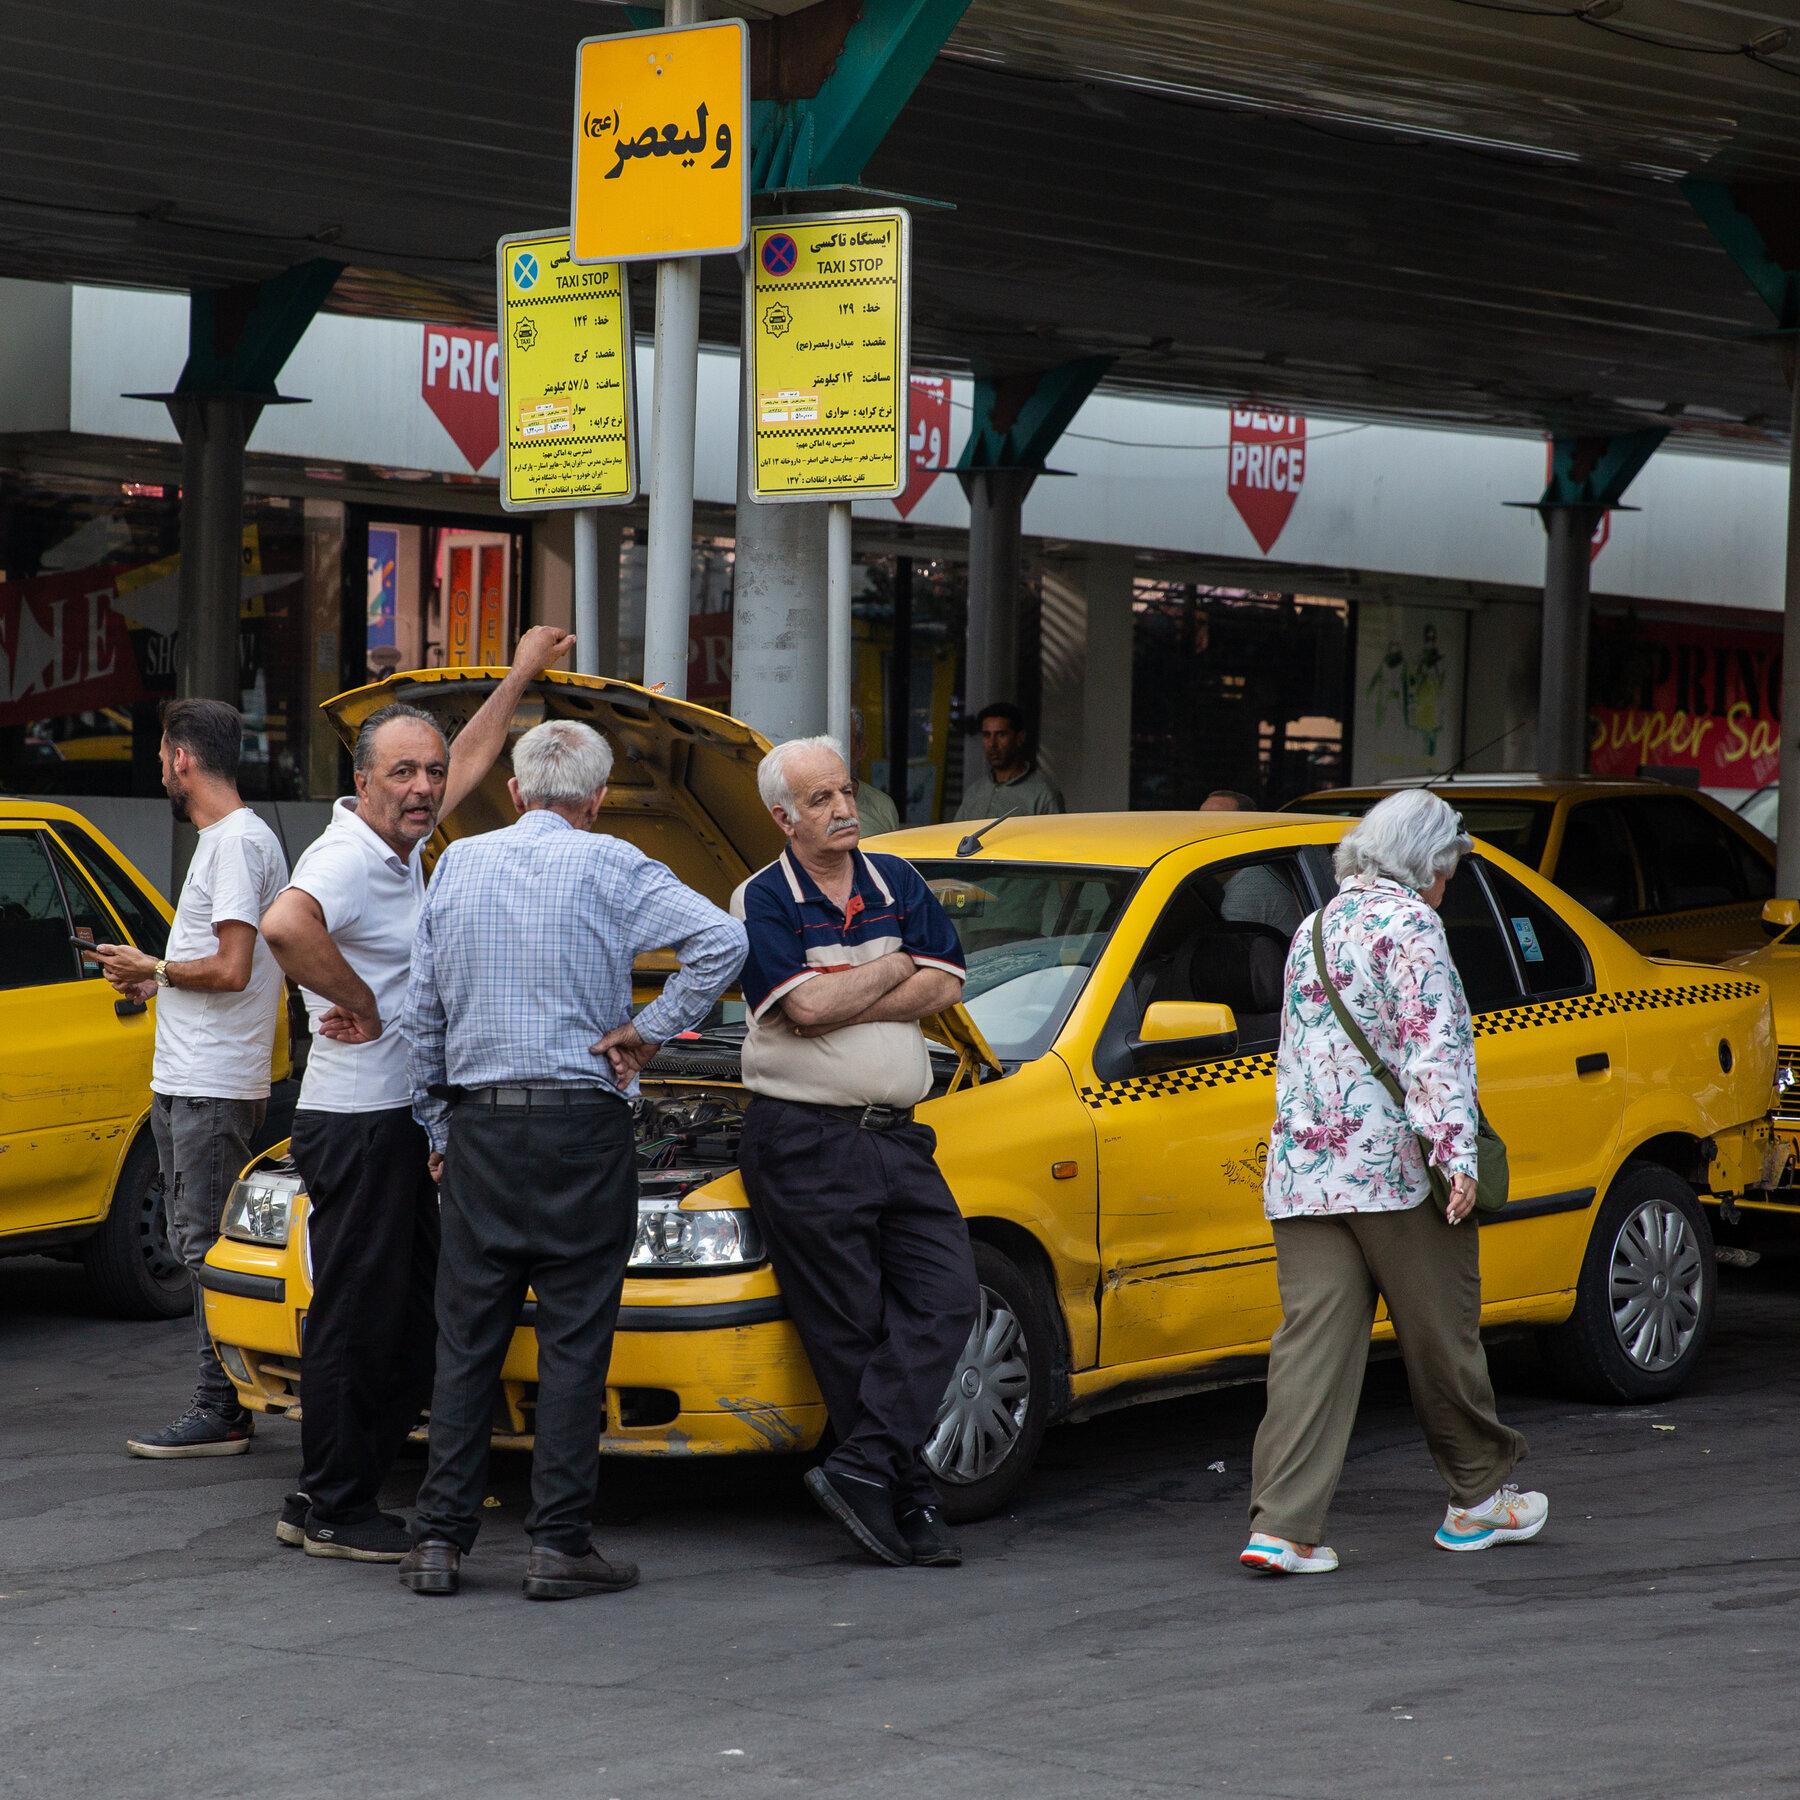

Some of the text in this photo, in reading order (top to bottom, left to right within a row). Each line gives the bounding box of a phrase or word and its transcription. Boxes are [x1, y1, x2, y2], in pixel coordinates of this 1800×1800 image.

[604, 101, 731, 179] ولیعصر
[810, 230, 891, 253] ایستگاه تاکسی
[817, 258, 883, 274] TAXI STOP
[556, 272, 609, 289] TAXI STOP
[838, 303, 881, 315] خط: ۱۲۹
[574, 315, 609, 327] خط: ۱۲۴
[835, 339, 854, 349] میدان
[862, 336, 886, 347] مقصد:
[574, 349, 615, 363] مقصد: کرج
[596, 378, 620, 389] مسافت:
[812, 372, 891, 387] مسافت: ۱۴ کیلومتر
[544, 381, 566, 396] کیلومتر
[825, 407, 850, 418] سواری
[878, 405, 892, 418] نرخ
[611, 415, 623, 427] نرخ
[796, 442, 808, 450] مهم:
[809, 440, 825, 449] اماکن
[832, 439, 855, 448] دسترسی
[553, 450, 567, 458] اماکن
[573, 448, 592, 457] دسترسی
[869, 453, 892, 462] بیمارستان
[602, 457, 623, 466] بیمارستان
[760, 457, 771, 467] آبان
[781, 458, 800, 466] داروخانه
[830, 455, 853, 464] بیمارستان
[1231, 440, 1303, 493] PRICE
[806, 474, 827, 484] انتقادات
[833, 474, 852, 483] شکایات
[853, 474, 865, 483] تلفن
[574, 485, 591, 493] شکایات
[592, 484, 602, 492] تلفن
[0, 587, 117, 704] ALE
